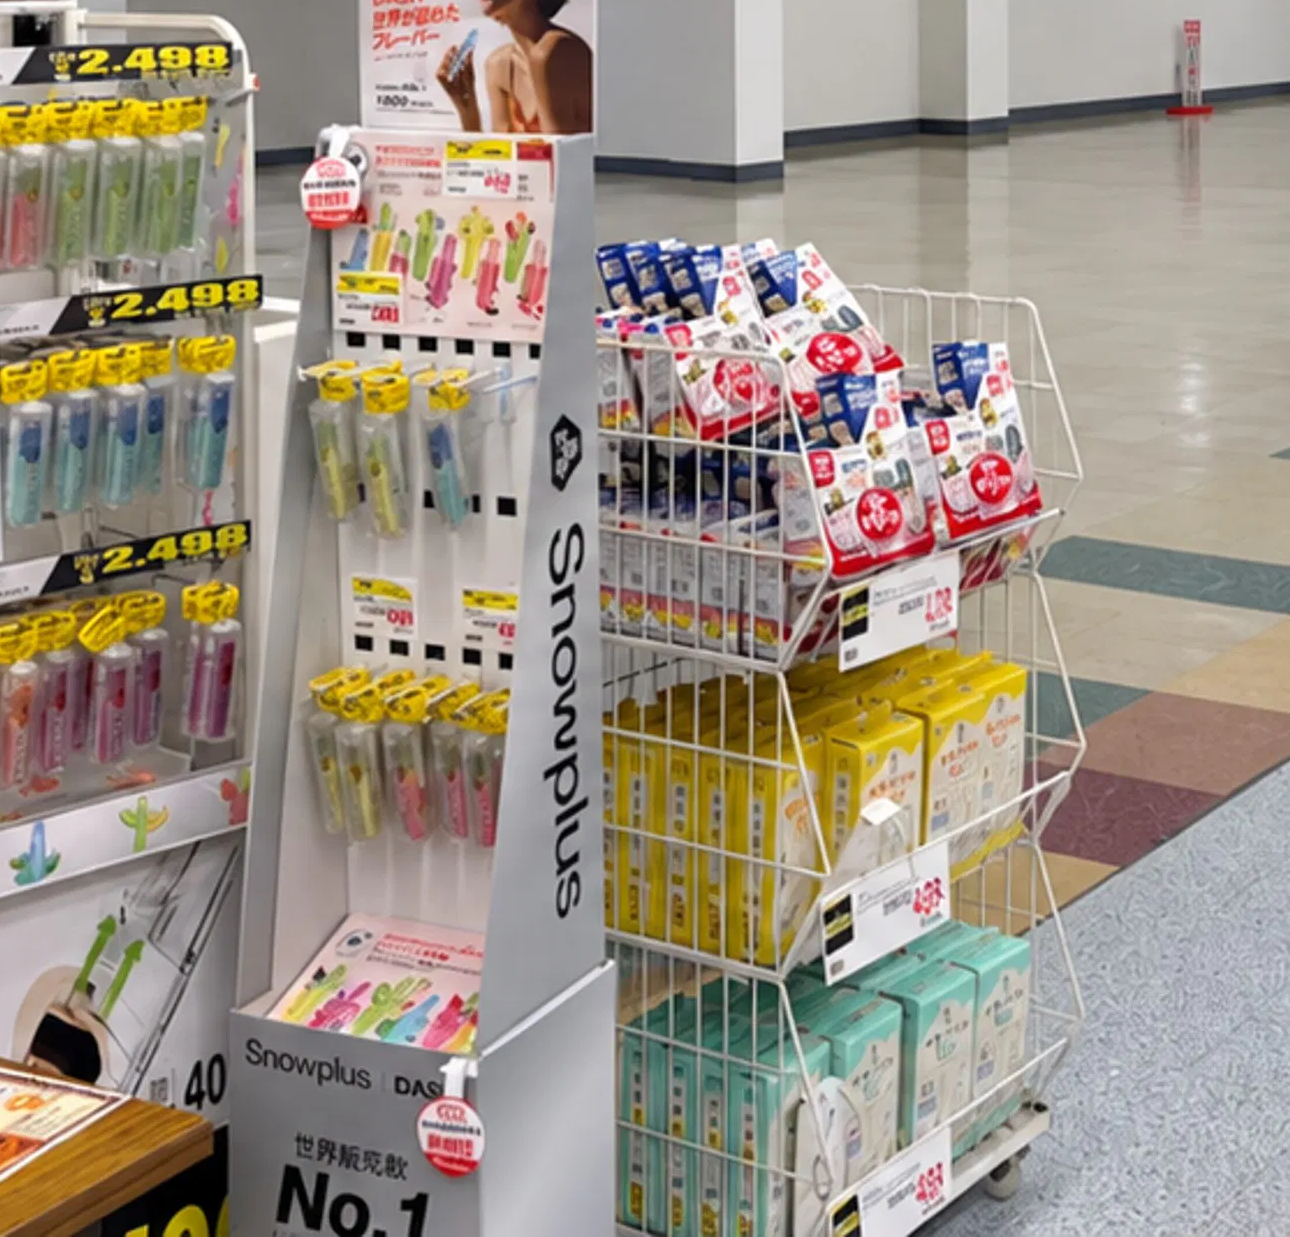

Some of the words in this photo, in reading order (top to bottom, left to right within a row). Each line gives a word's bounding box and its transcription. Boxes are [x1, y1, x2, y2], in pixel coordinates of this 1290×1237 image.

[544, 523, 591, 919] Snowplus
[245, 1037, 372, 1090] Snowplus
[394, 1074, 445, 1099] DAS
[275, 1162, 430, 1237] No.1
